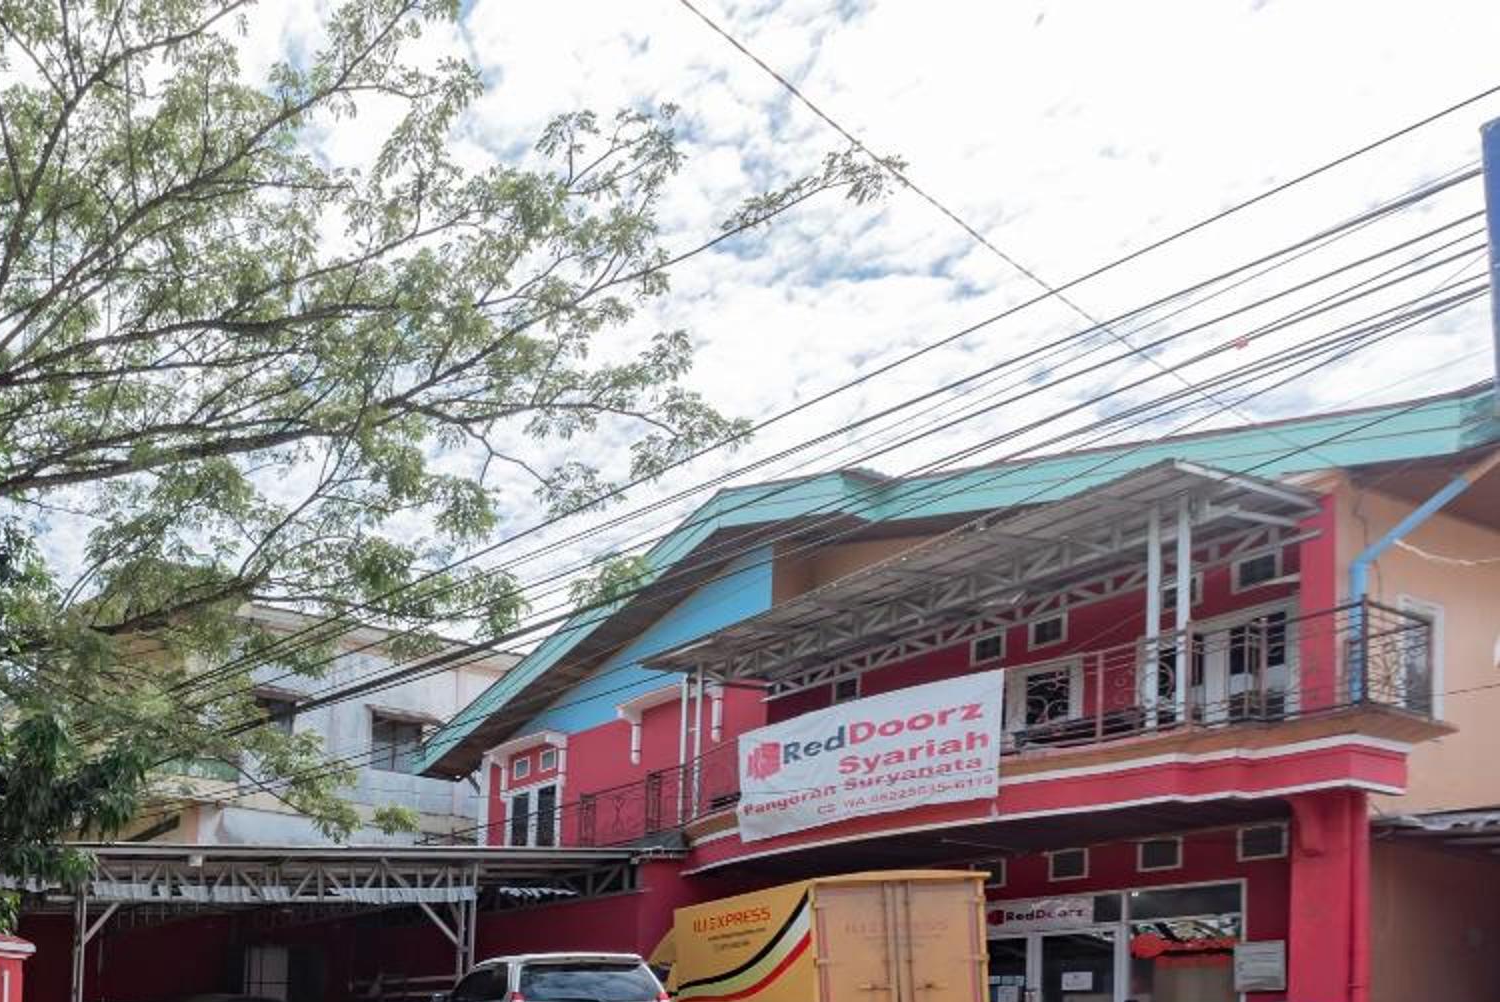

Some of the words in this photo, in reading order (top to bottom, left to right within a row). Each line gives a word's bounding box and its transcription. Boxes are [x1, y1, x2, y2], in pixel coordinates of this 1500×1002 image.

[783, 702, 983, 764] RedDoorz
[839, 732, 989, 775] Syariah
[843, 757, 982, 791] Suryanata
